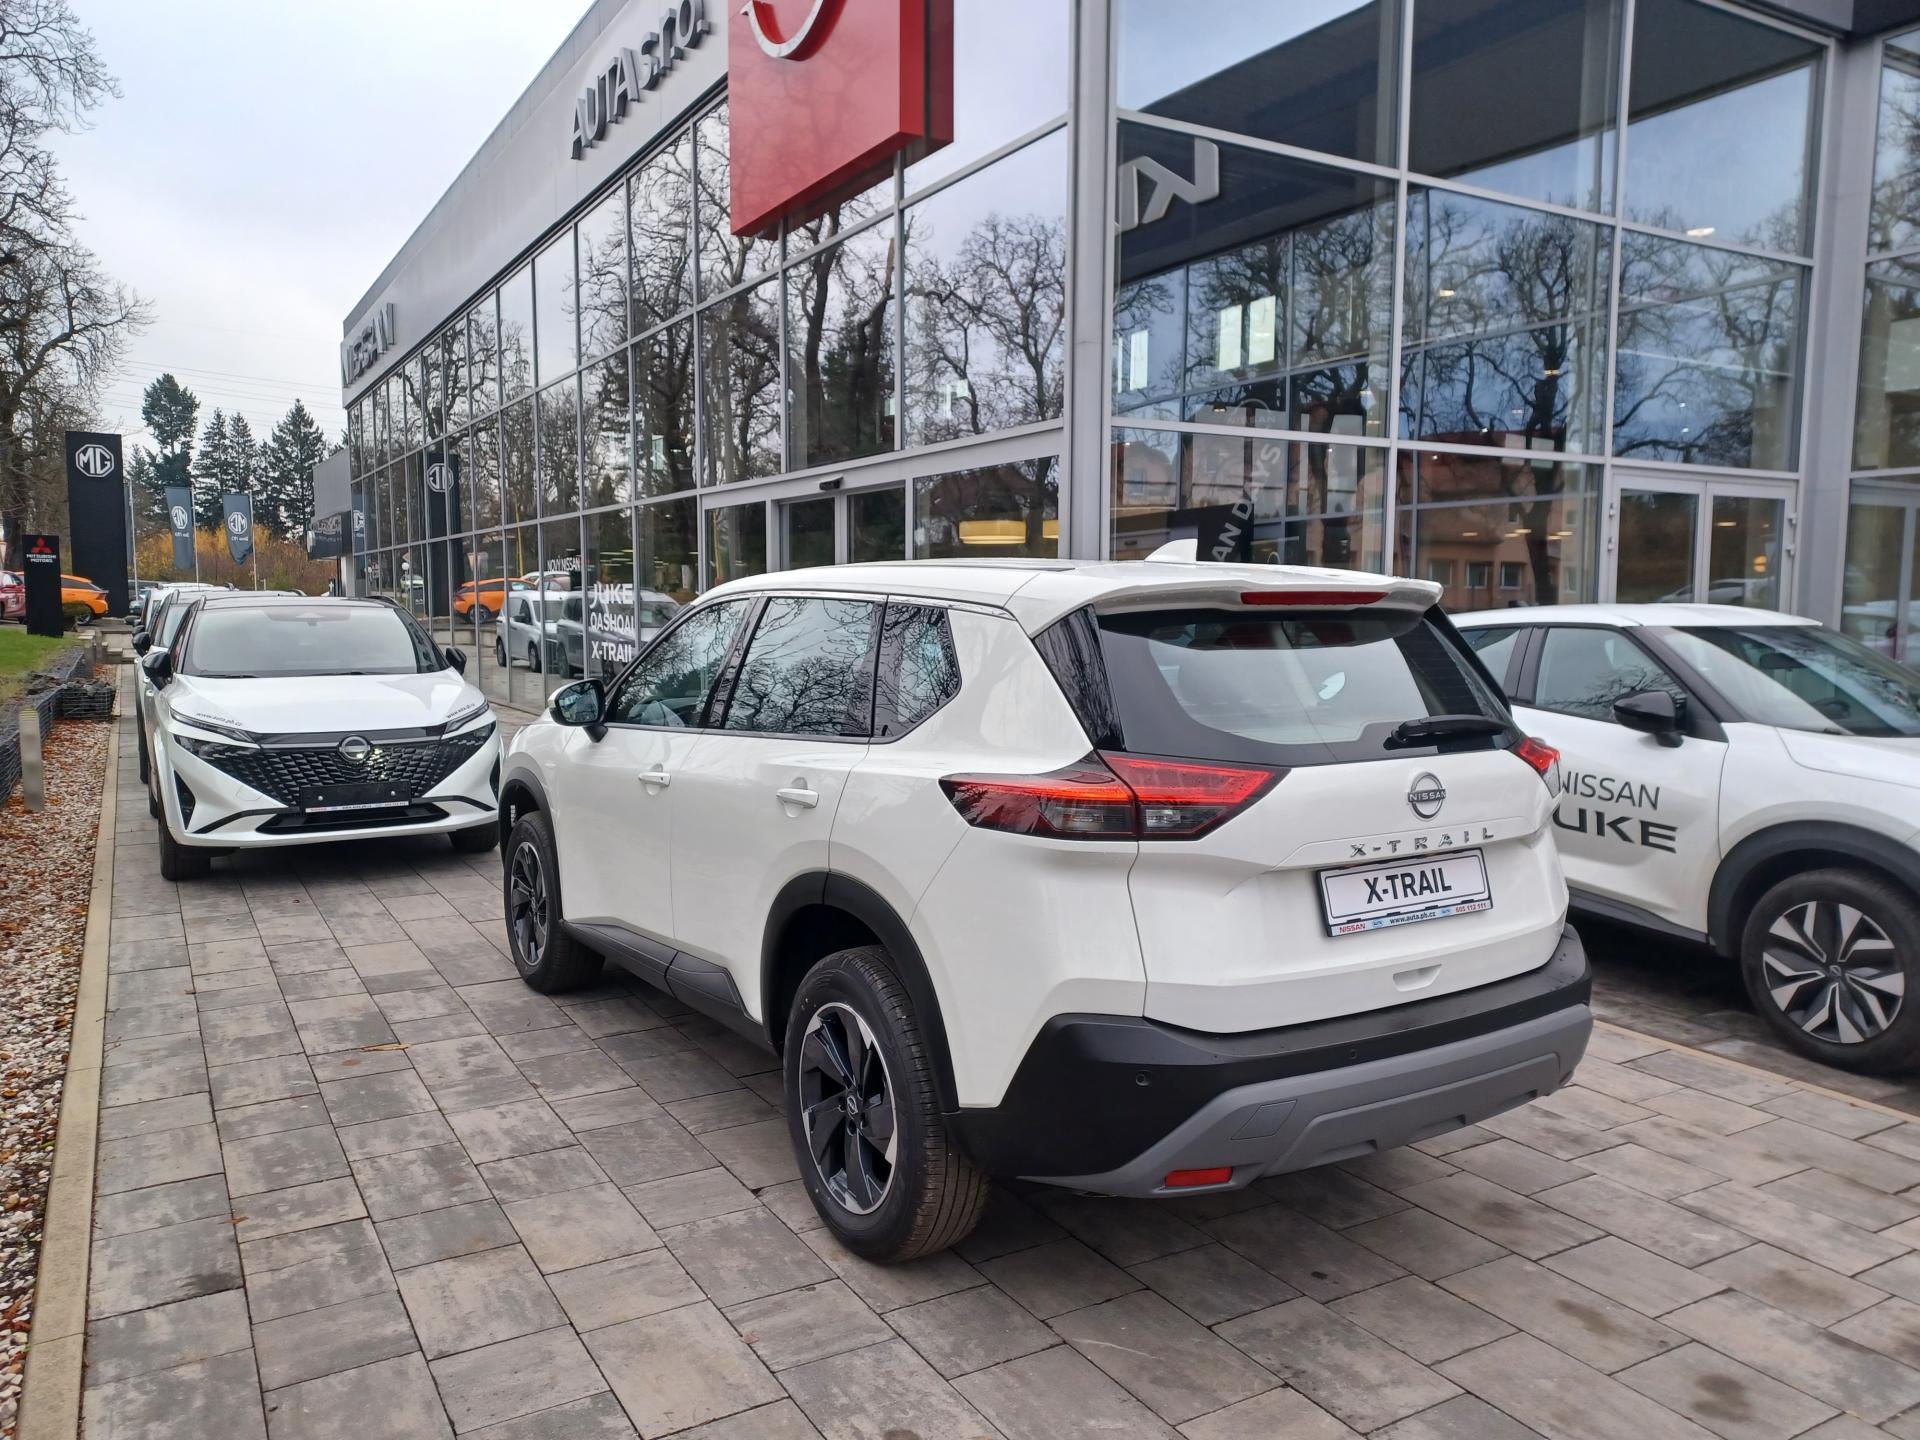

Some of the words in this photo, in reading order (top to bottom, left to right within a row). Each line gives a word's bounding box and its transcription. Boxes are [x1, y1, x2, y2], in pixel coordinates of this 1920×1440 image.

[571, 47, 640, 160] AUTA
[77, 446, 113, 476] MG
[589, 583, 634, 609] JUKE
[1409, 789, 1447, 801] NISSAN
[1350, 827, 1494, 858] X-TRAIL
[1363, 868, 1452, 904] X-TRAIL
[1339, 923, 1366, 934] NISSAN
